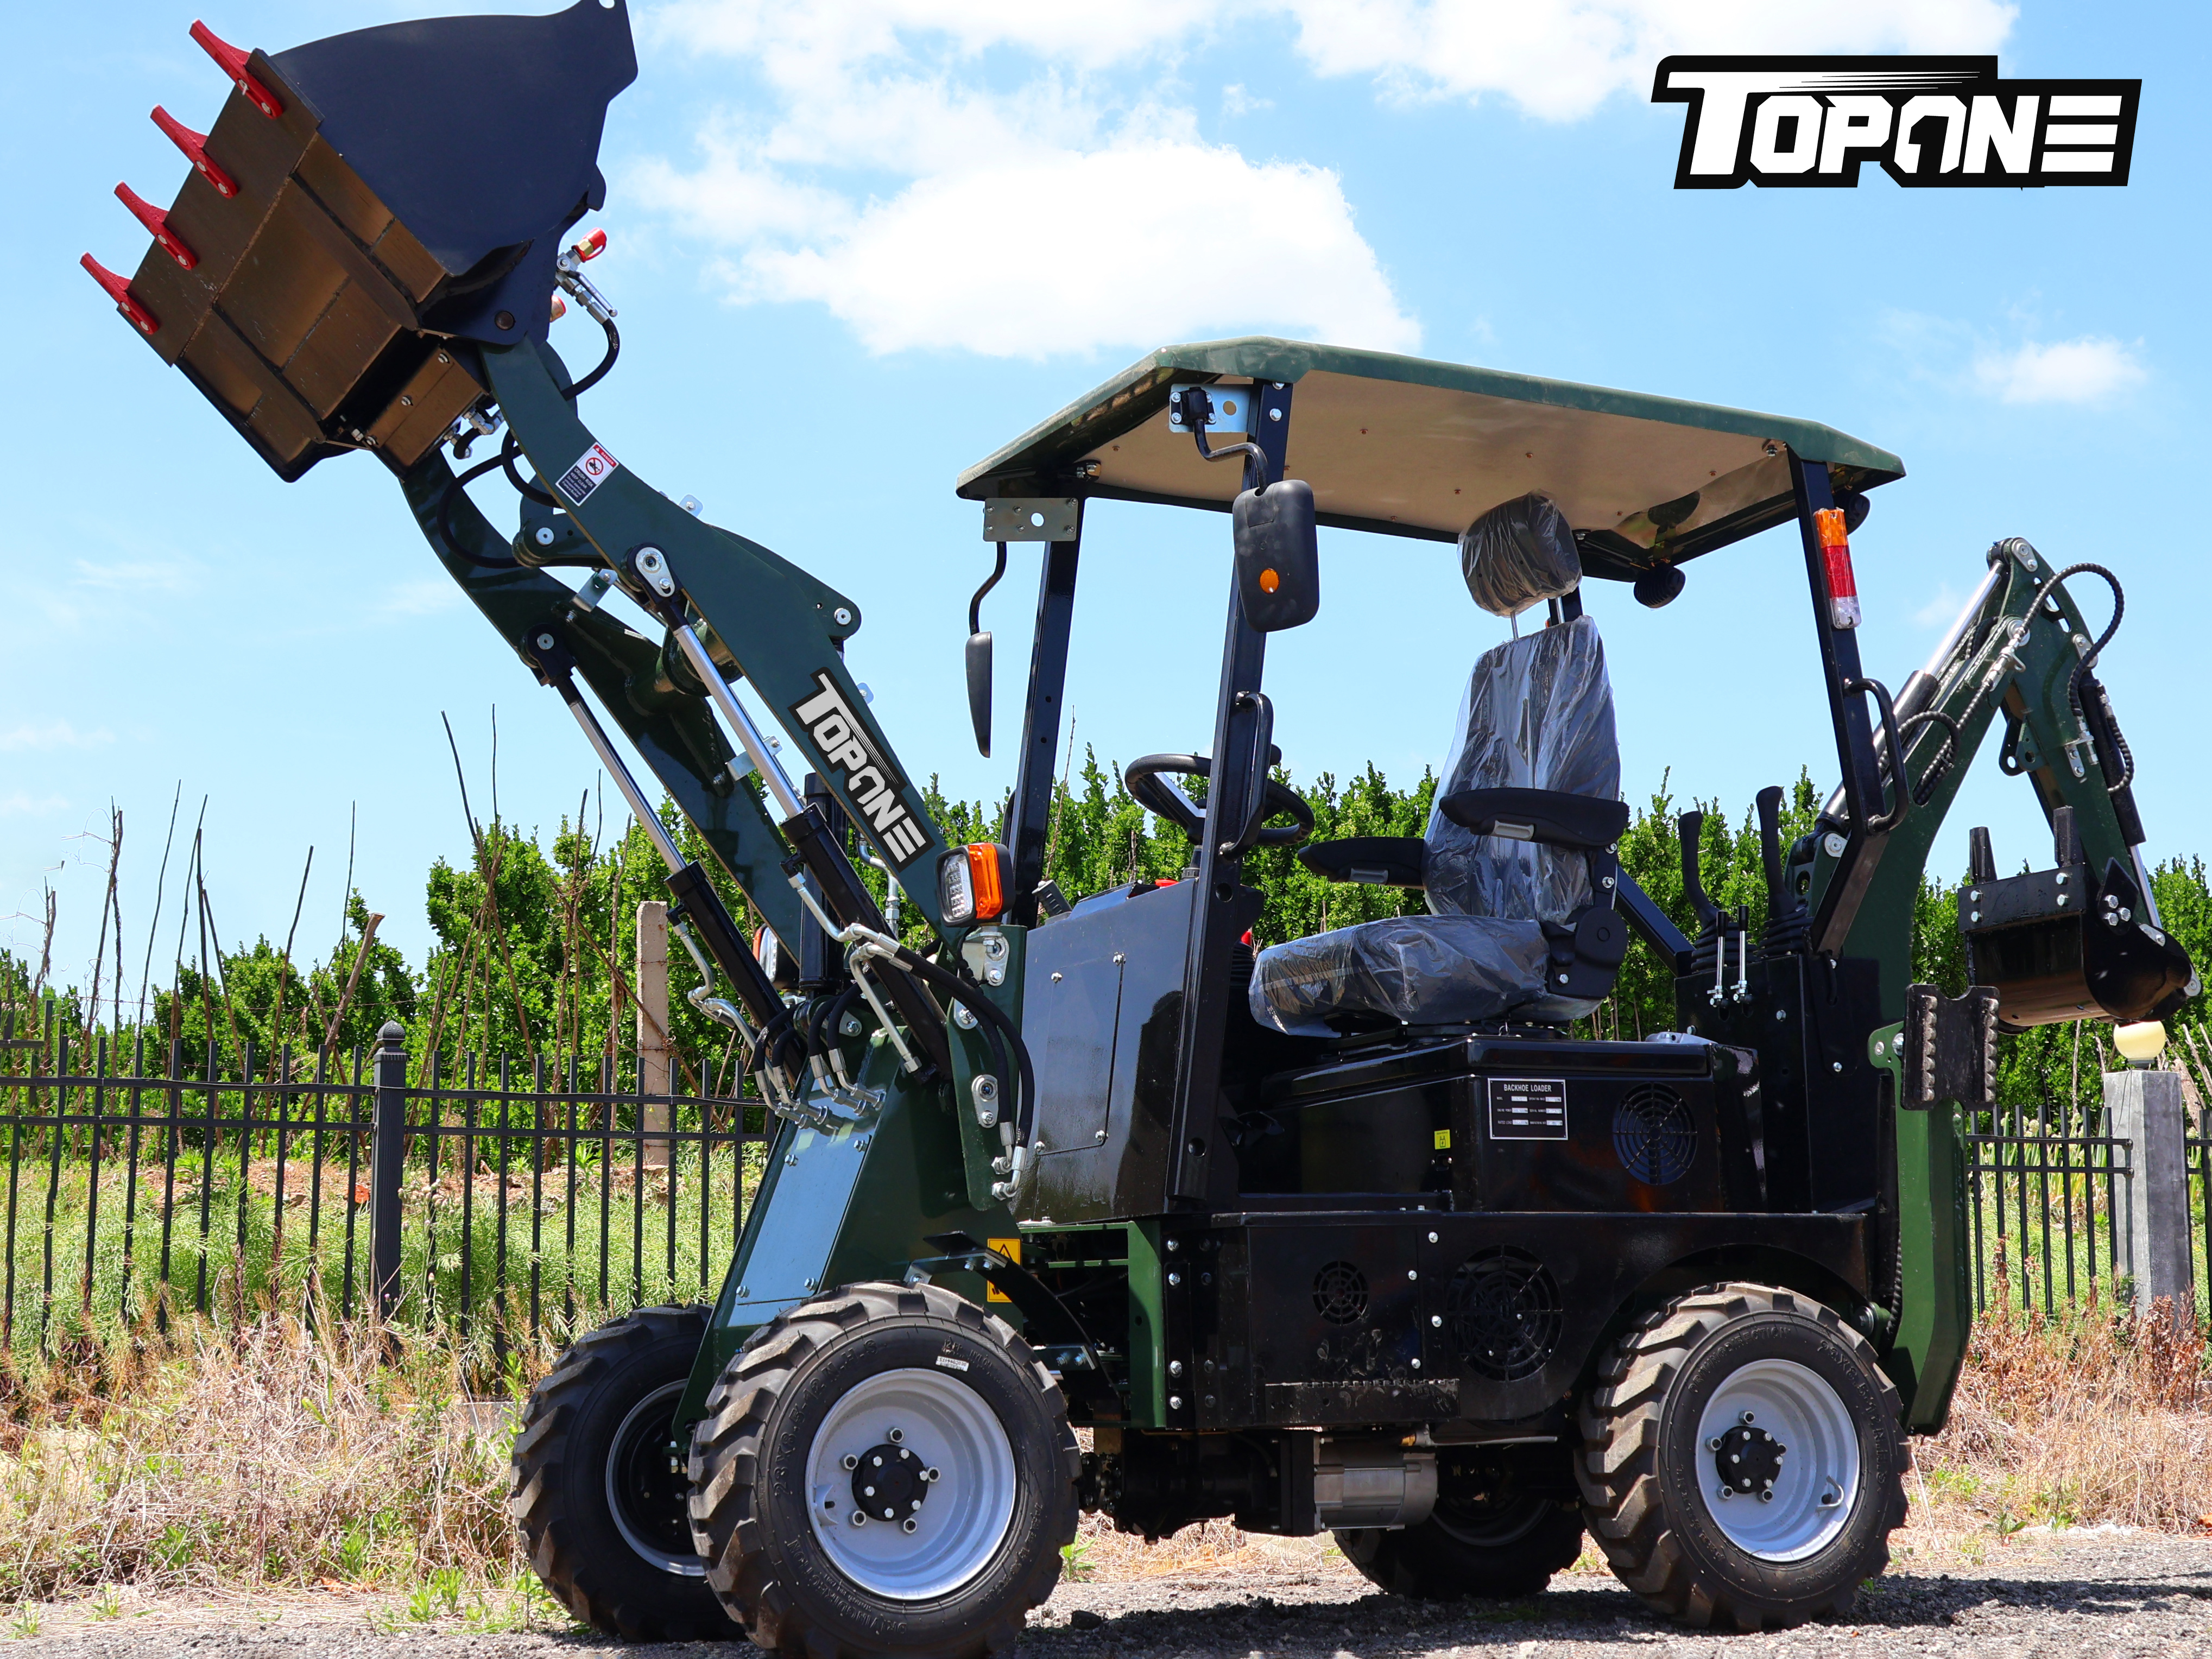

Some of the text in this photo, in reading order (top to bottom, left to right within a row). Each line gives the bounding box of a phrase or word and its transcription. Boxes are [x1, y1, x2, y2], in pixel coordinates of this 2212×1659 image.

[601, 452, 614, 465] DANGER
[570, 472, 587, 489] KEEP CLEAR
[573, 467, 594, 488] CRUSH RISK
[1504, 1084, 1528, 1092] BACKHOE
